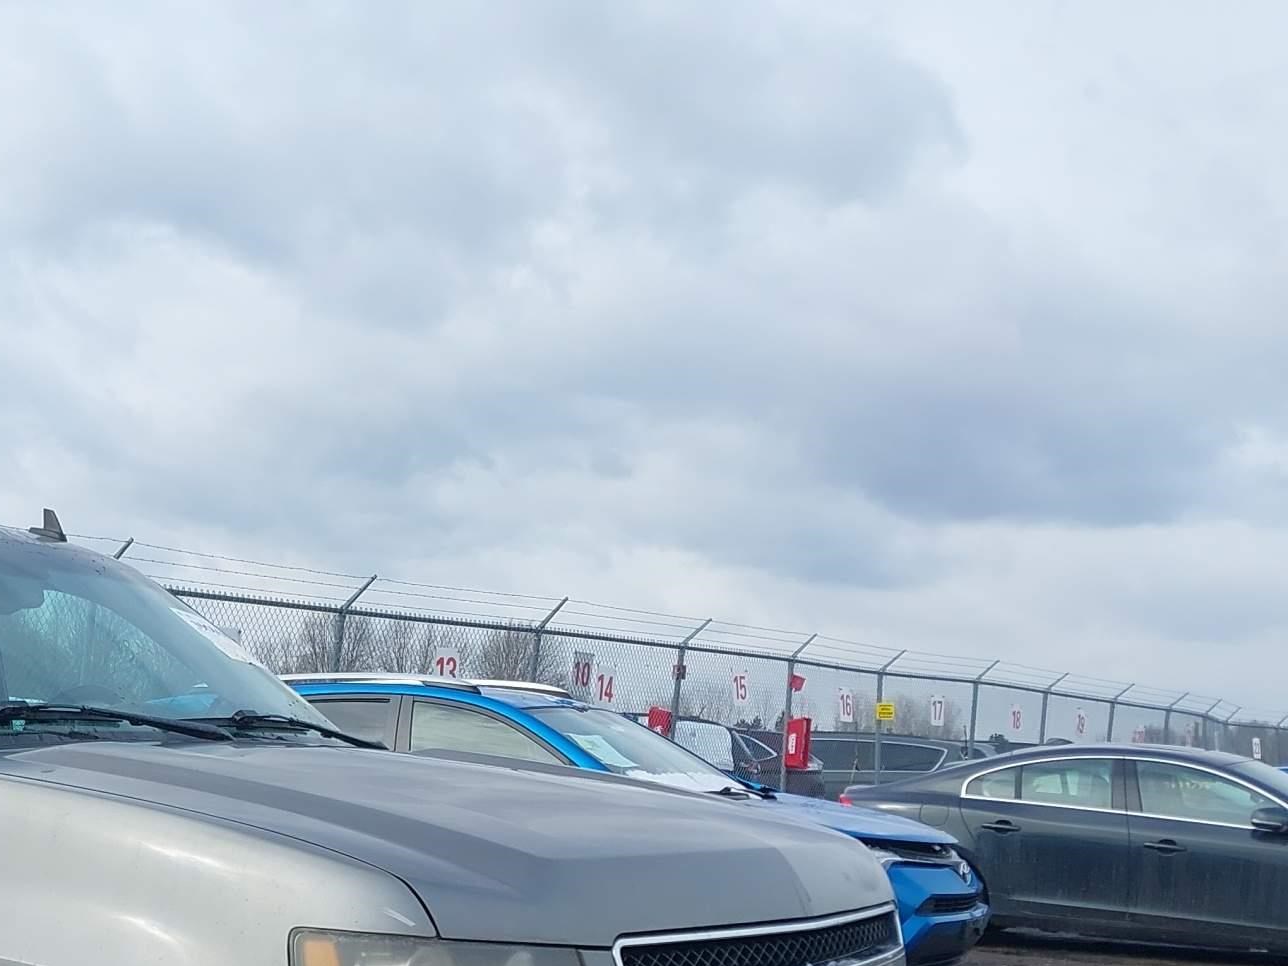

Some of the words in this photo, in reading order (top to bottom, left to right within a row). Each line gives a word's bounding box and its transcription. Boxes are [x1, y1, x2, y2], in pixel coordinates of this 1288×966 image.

[574, 661, 591, 688] 10
[598, 673, 614, 703] 14
[733, 675, 748, 700] 15
[840, 693, 852, 717] 16
[932, 700, 943, 721] 17
[1012, 710, 1022, 730] 18
